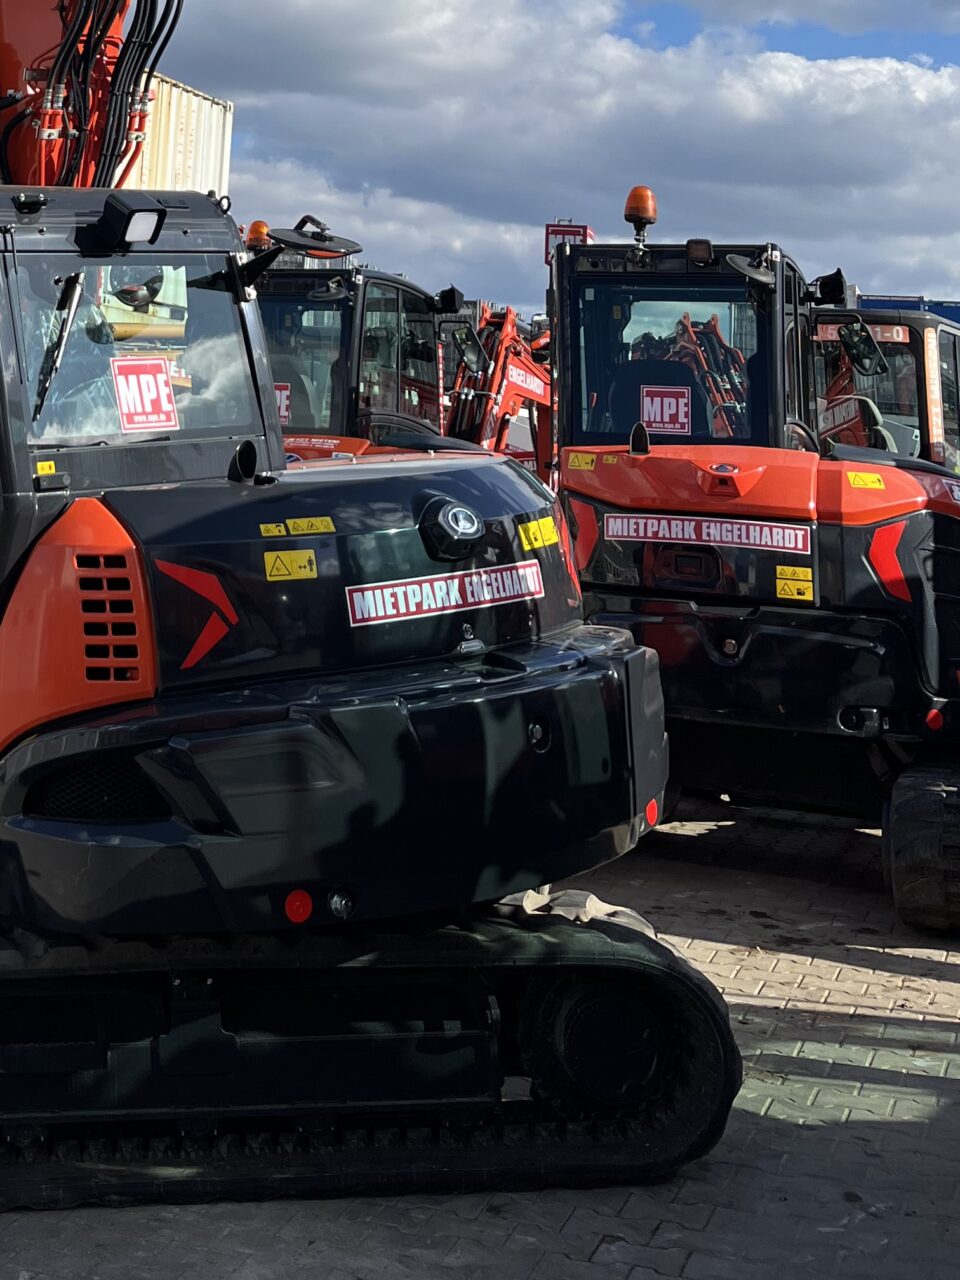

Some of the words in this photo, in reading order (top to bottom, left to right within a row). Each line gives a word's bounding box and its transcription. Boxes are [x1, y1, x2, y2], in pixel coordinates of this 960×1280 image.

[117, 373, 173, 413] MPE
[508, 364, 544, 396] ENGELHARDT
[643, 397, 688, 423] MPE
[608, 517, 697, 540] MIETPARK
[701, 521, 805, 549] ENGELHARDT
[352, 577, 463, 620] MIETPARK
[464, 566, 540, 604] ENGELHARDT
